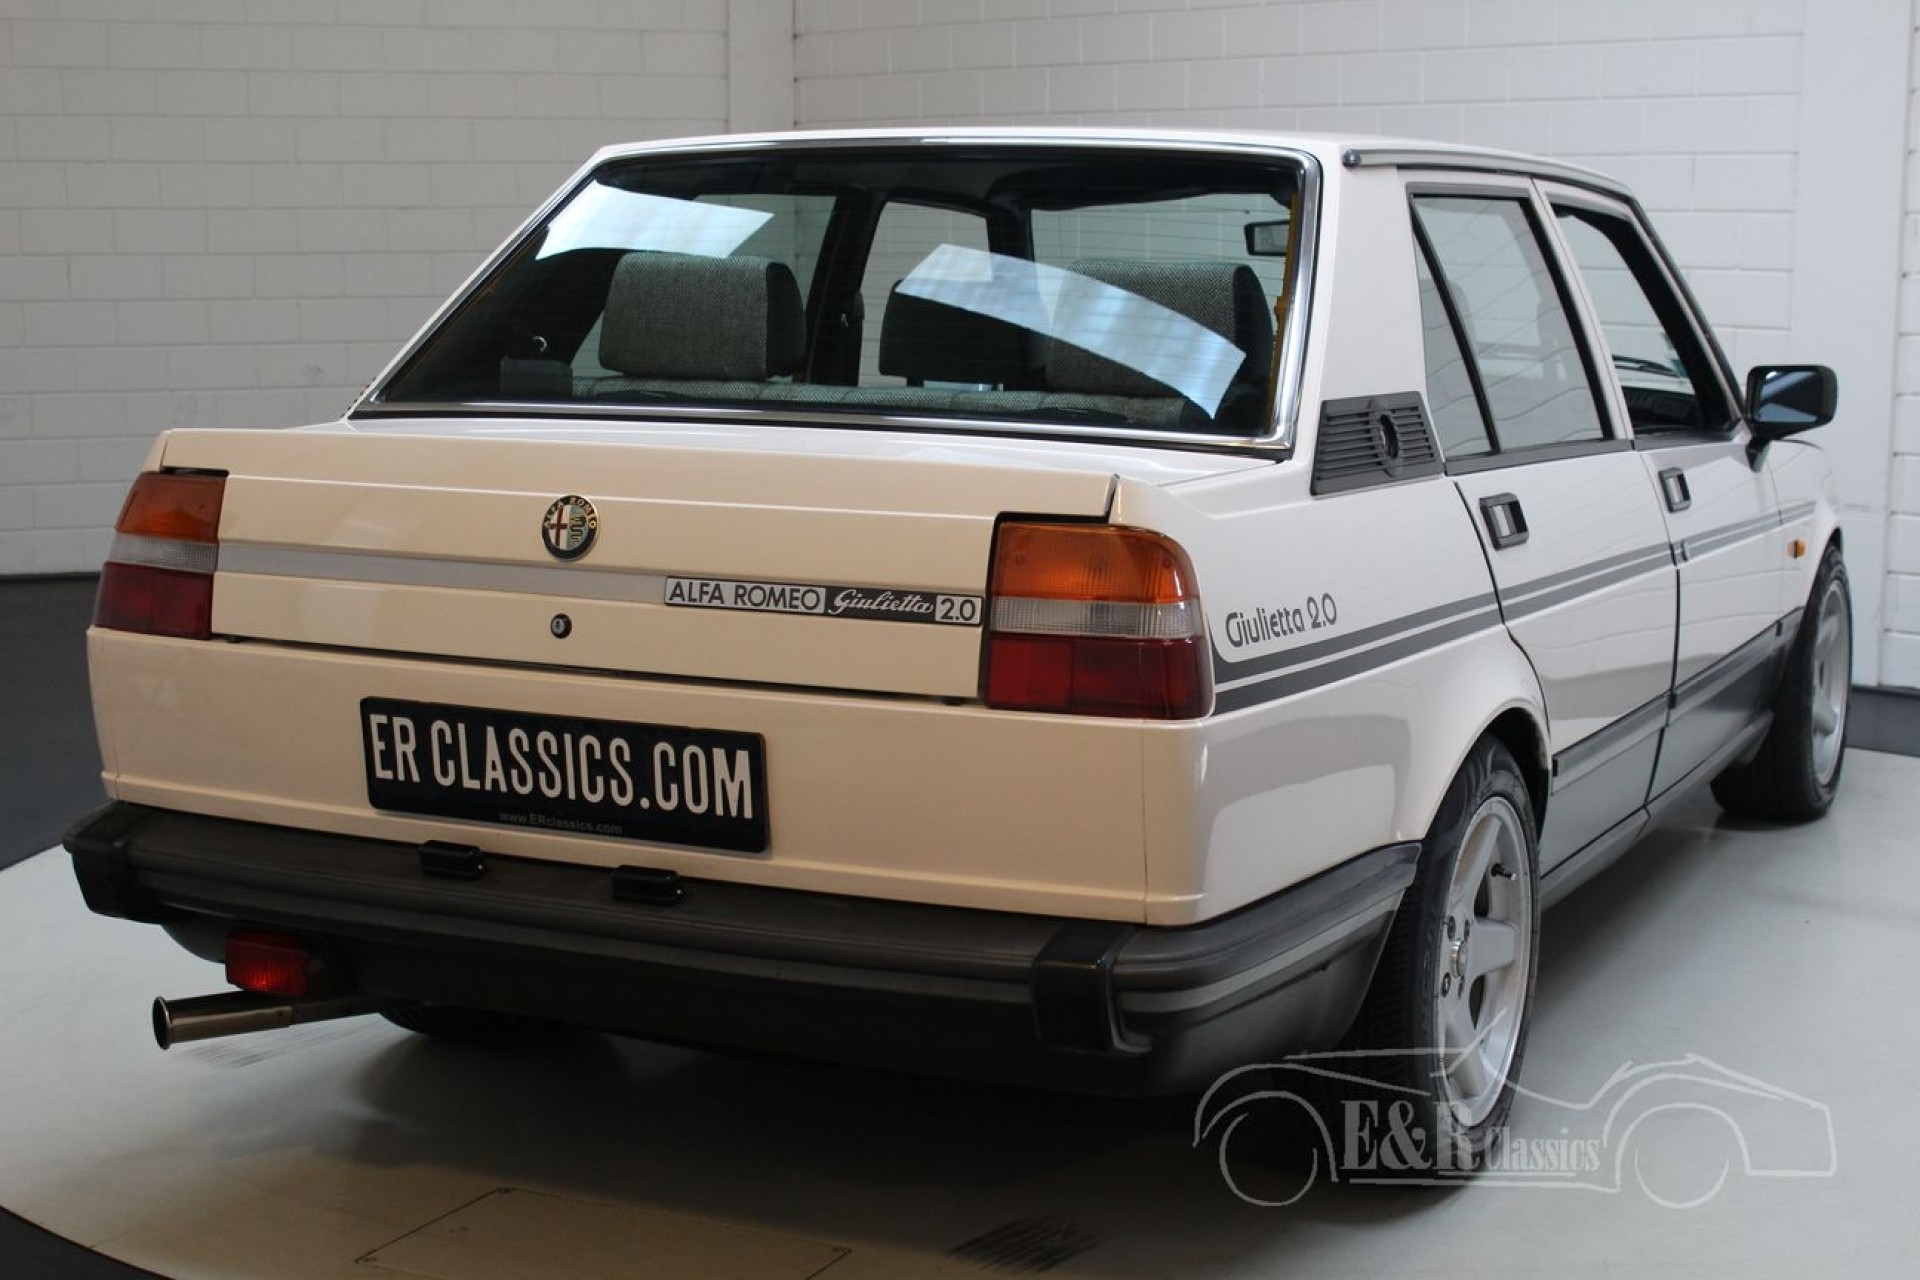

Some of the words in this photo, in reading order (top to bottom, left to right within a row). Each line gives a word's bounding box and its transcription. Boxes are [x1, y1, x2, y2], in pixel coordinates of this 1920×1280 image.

[669, 580, 725, 605] ALFA
[734, 584, 820, 611] ROMEO
[827, 588, 934, 616] Giulietta
[940, 597, 976, 622] 2.0
[1225, 607, 1306, 648] Giulietta
[1306, 592, 1337, 630] 2.0
[369, 713, 420, 784] ER
[430, 719, 754, 820] CLASSICS.COM
[499, 812, 623, 836] www.ERclassics.com
